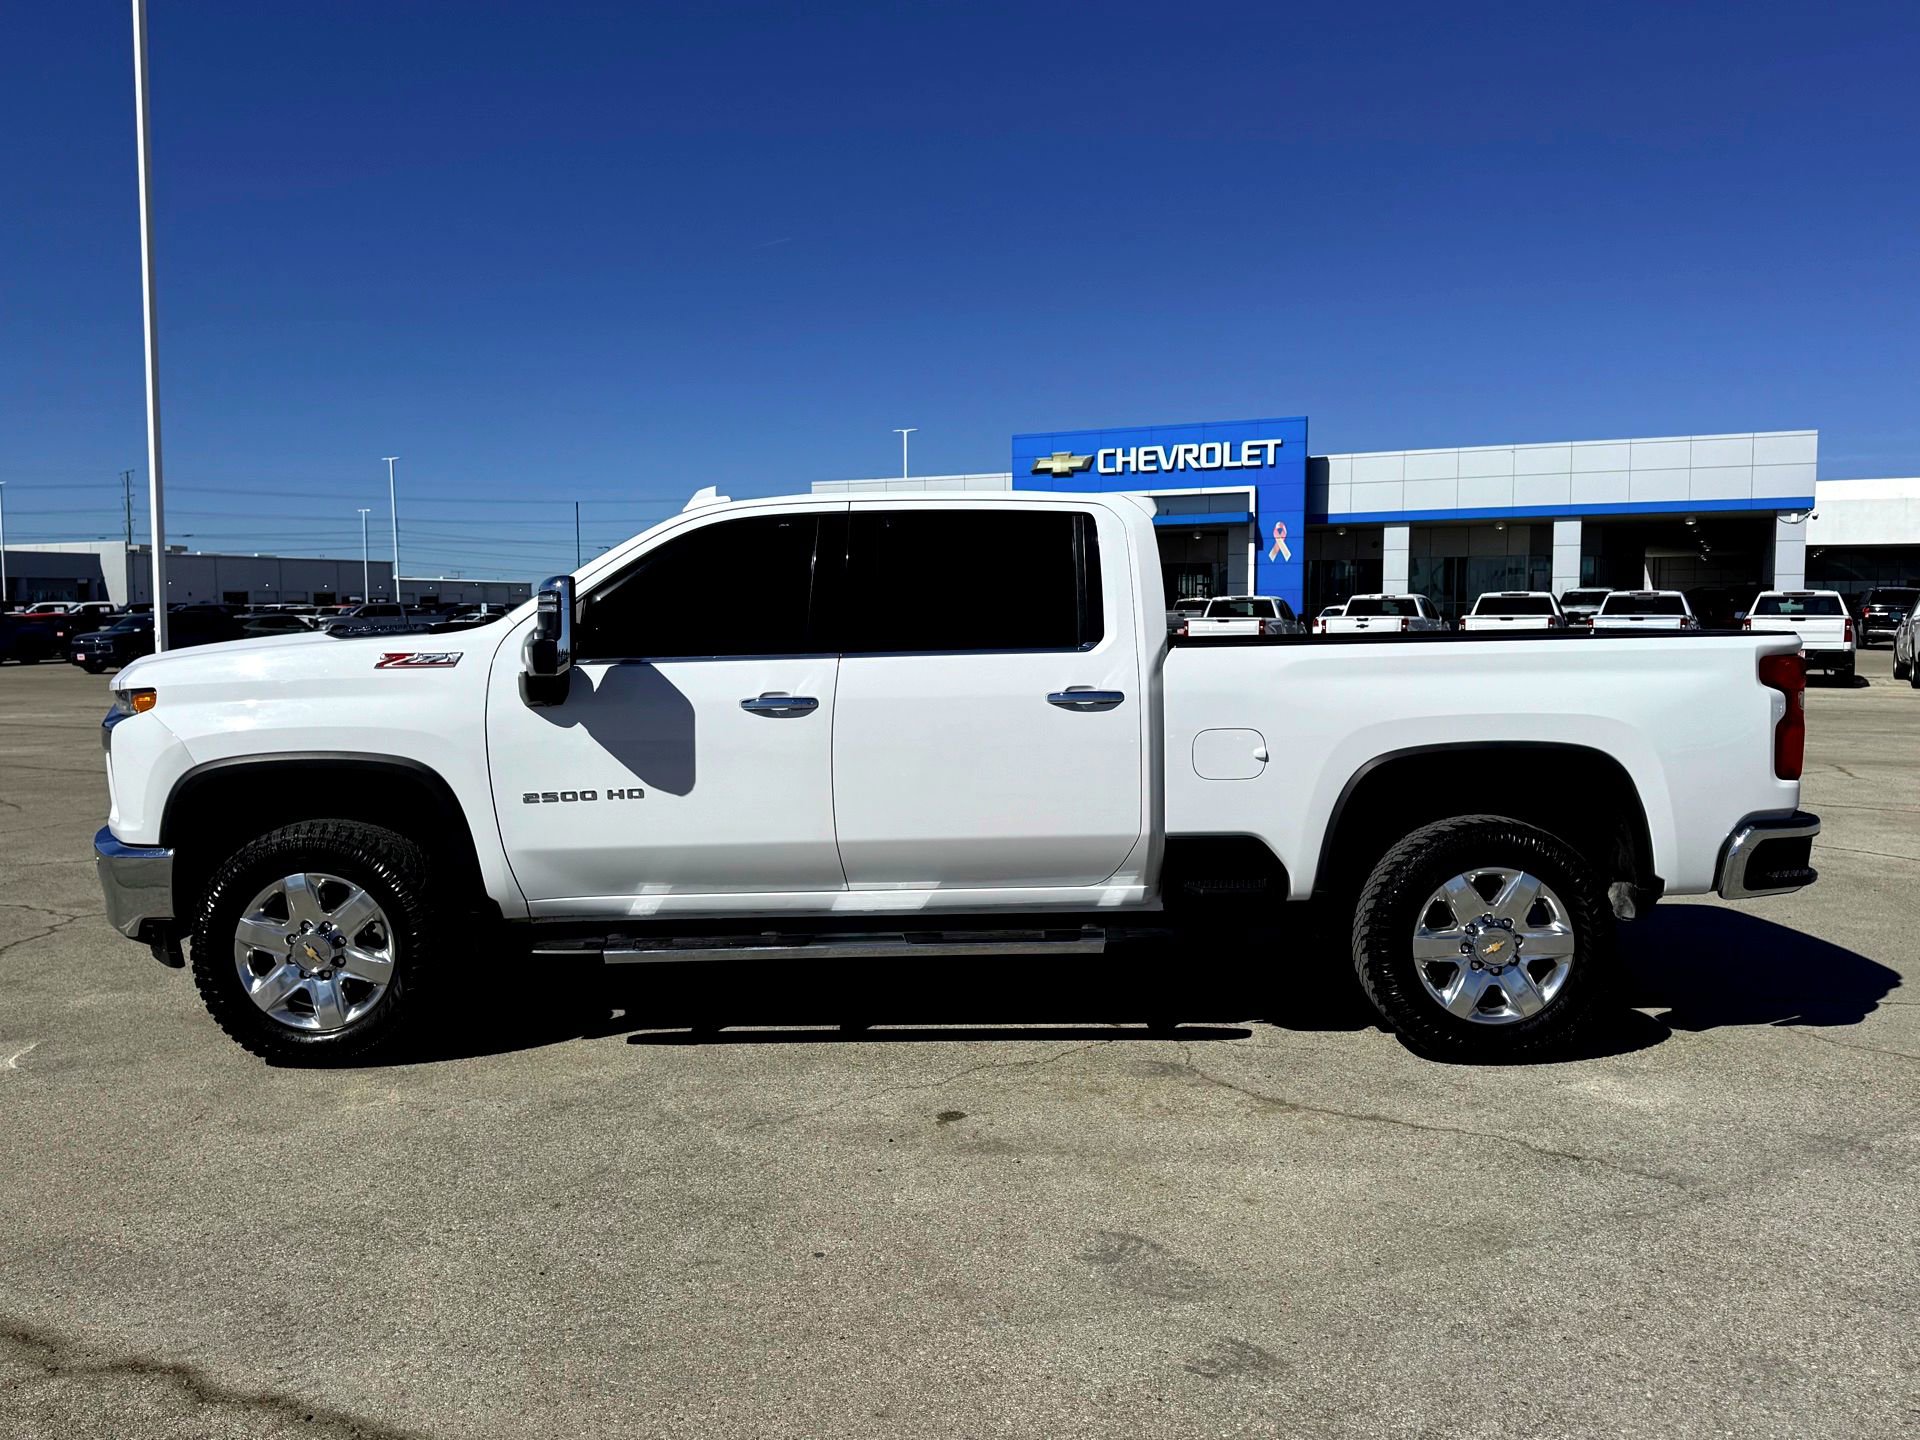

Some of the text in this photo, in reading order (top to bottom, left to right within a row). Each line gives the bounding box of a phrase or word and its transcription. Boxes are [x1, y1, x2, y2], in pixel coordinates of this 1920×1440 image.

[1097, 439, 1282, 474] CHEVROLET
[374, 652, 464, 669] Z71
[522, 788, 645, 804] 2500 HD
